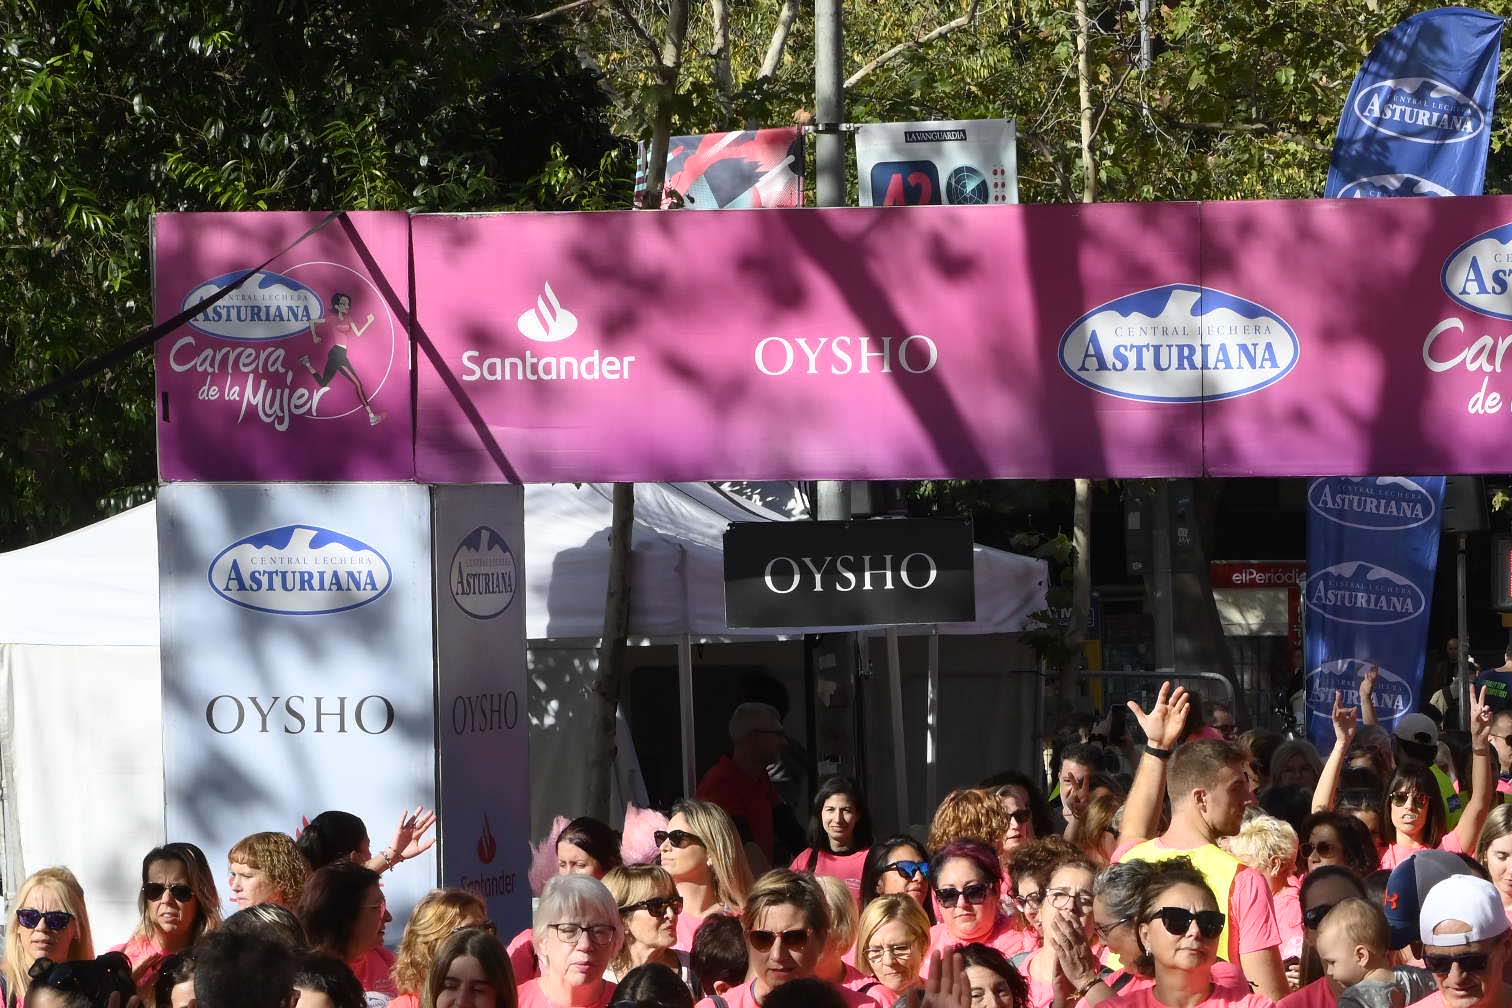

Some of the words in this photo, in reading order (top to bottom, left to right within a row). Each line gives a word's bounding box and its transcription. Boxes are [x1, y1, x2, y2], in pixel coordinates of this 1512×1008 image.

[1363, 91, 1474, 133] ASTURIANA
[1114, 326, 1190, 338] CENTRAL
[1198, 324, 1272, 337] LECHERA
[169, 336, 285, 374] Carrera
[462, 349, 636, 382] Santander
[754, 335, 939, 376] OYSHO
[1077, 329, 1281, 374] ASTURIANA
[198, 377, 221, 401] de
[224, 375, 240, 401] la
[238, 369, 331, 432] Mujer
[1467, 378, 1503, 415] de
[1318, 484, 1424, 519] ASTURIANA
[223, 559, 379, 592] ASTURIANA
[250, 555, 308, 566] CENTRAL
[314, 555, 373, 566] LECHERA
[456, 562, 513, 596] ASTURIANA
[763, 552, 937, 594] OYSHO
[1311, 577, 1414, 614] ASTURIANA
[205, 694, 395, 735] OYSHO
[452, 690, 518, 735] OYSHO
